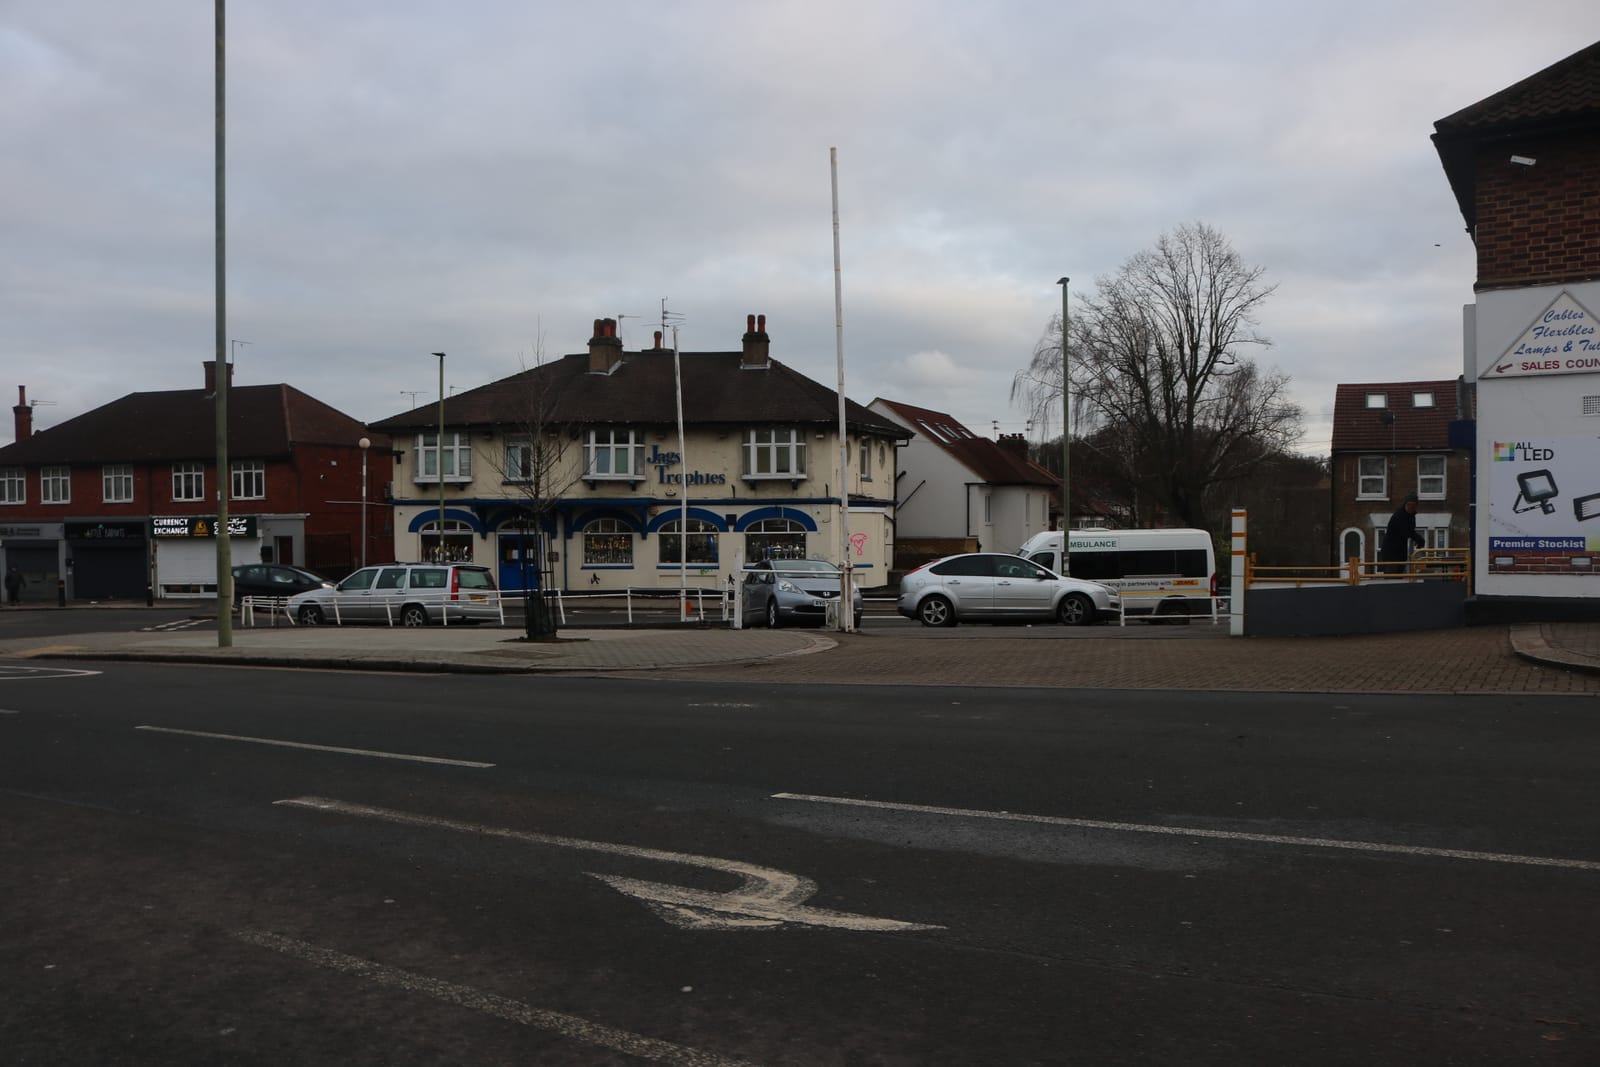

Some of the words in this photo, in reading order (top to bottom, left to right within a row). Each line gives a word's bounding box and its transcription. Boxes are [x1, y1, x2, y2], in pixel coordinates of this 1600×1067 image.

[1543, 309, 1584, 323] Cables
[1532, 324, 1595, 339] Flexibles
[1513, 343, 1558, 356] Lamps
[1563, 340, 1573, 352] &
[1521, 360, 1560, 370] SALES
[647, 445, 681, 464] Jags
[1524, 449, 1554, 461] LED
[655, 465, 726, 487] Trophies
[153, 518, 189, 526] CURRENCY
[153, 527, 189, 535] EXCHANGE
[1070, 540, 1117, 548] MBULANCE
[1493, 540, 1535, 548] Premier
[1538, 540, 1584, 548] Stockist
[1127, 580, 1159, 588] partnership
